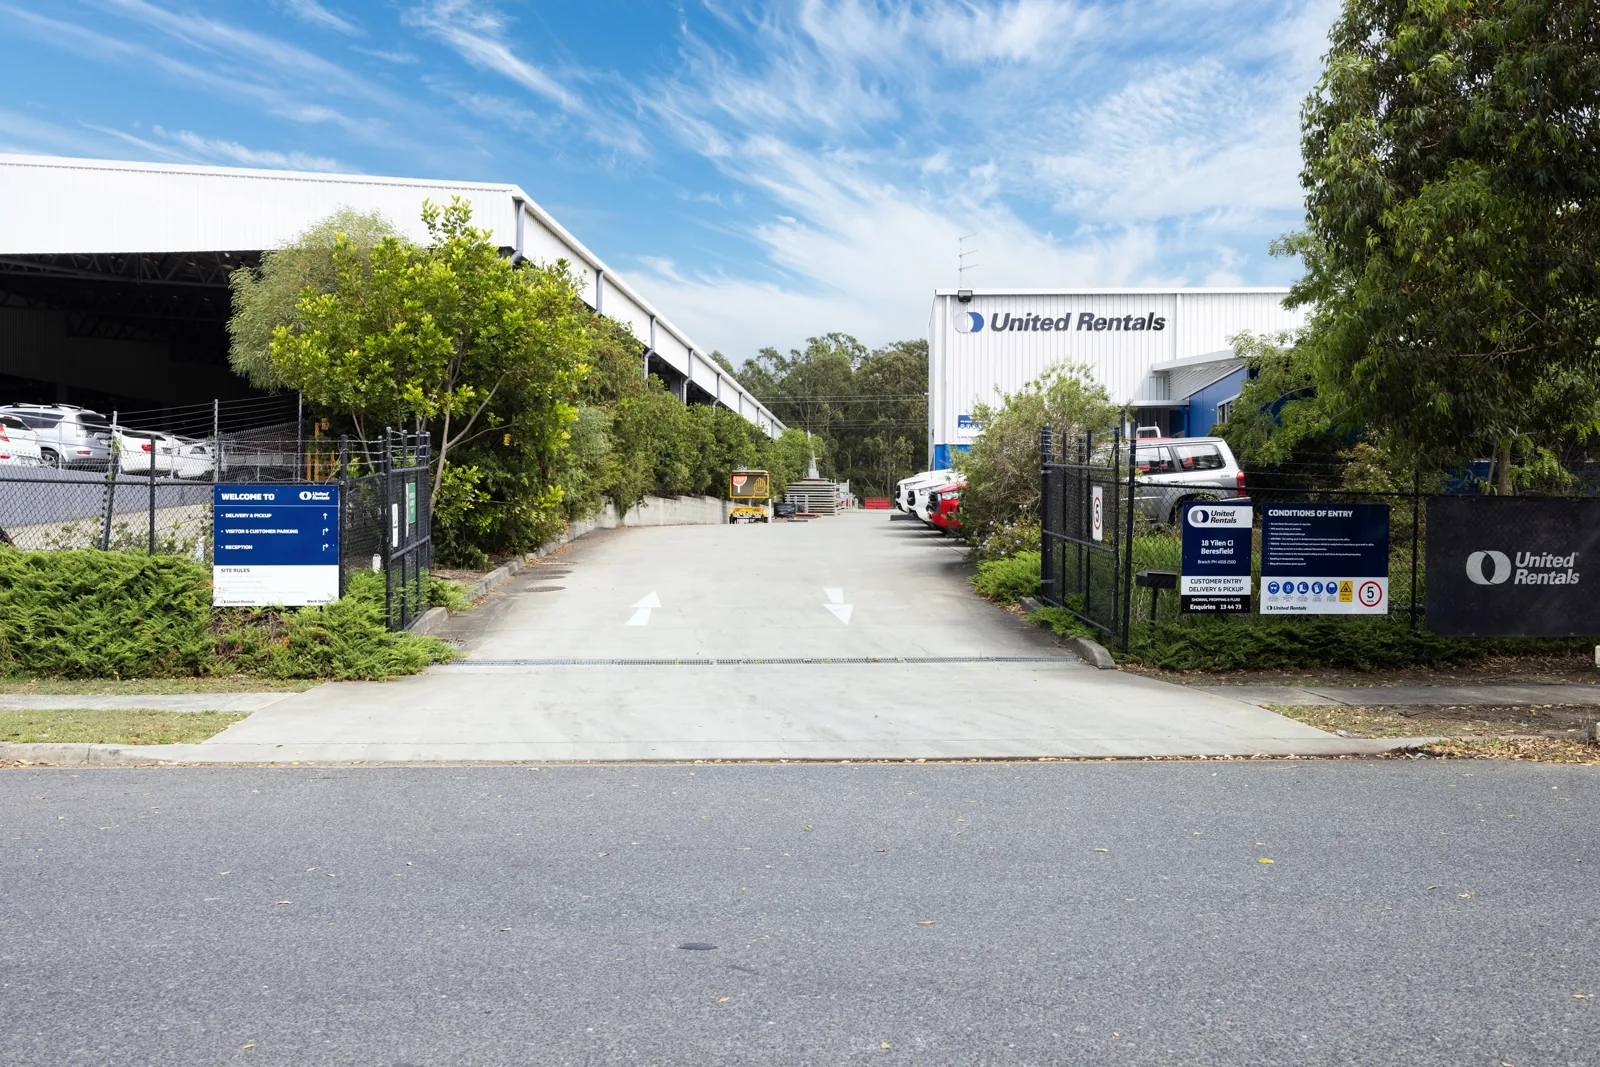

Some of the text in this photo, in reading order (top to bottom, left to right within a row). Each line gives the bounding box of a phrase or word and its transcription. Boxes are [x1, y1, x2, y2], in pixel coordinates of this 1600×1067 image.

[990, 312, 1166, 332] United Rentals
[221, 493, 275, 501] WELCOME TO
[1095, 503, 1100, 523] 5
[1268, 509, 1315, 517] CONDITIONS
[1327, 510, 1354, 518] ENTRY
[1515, 552, 1575, 568] United
[1514, 569, 1580, 584] Rentals
[1366, 586, 1374, 599] 5
